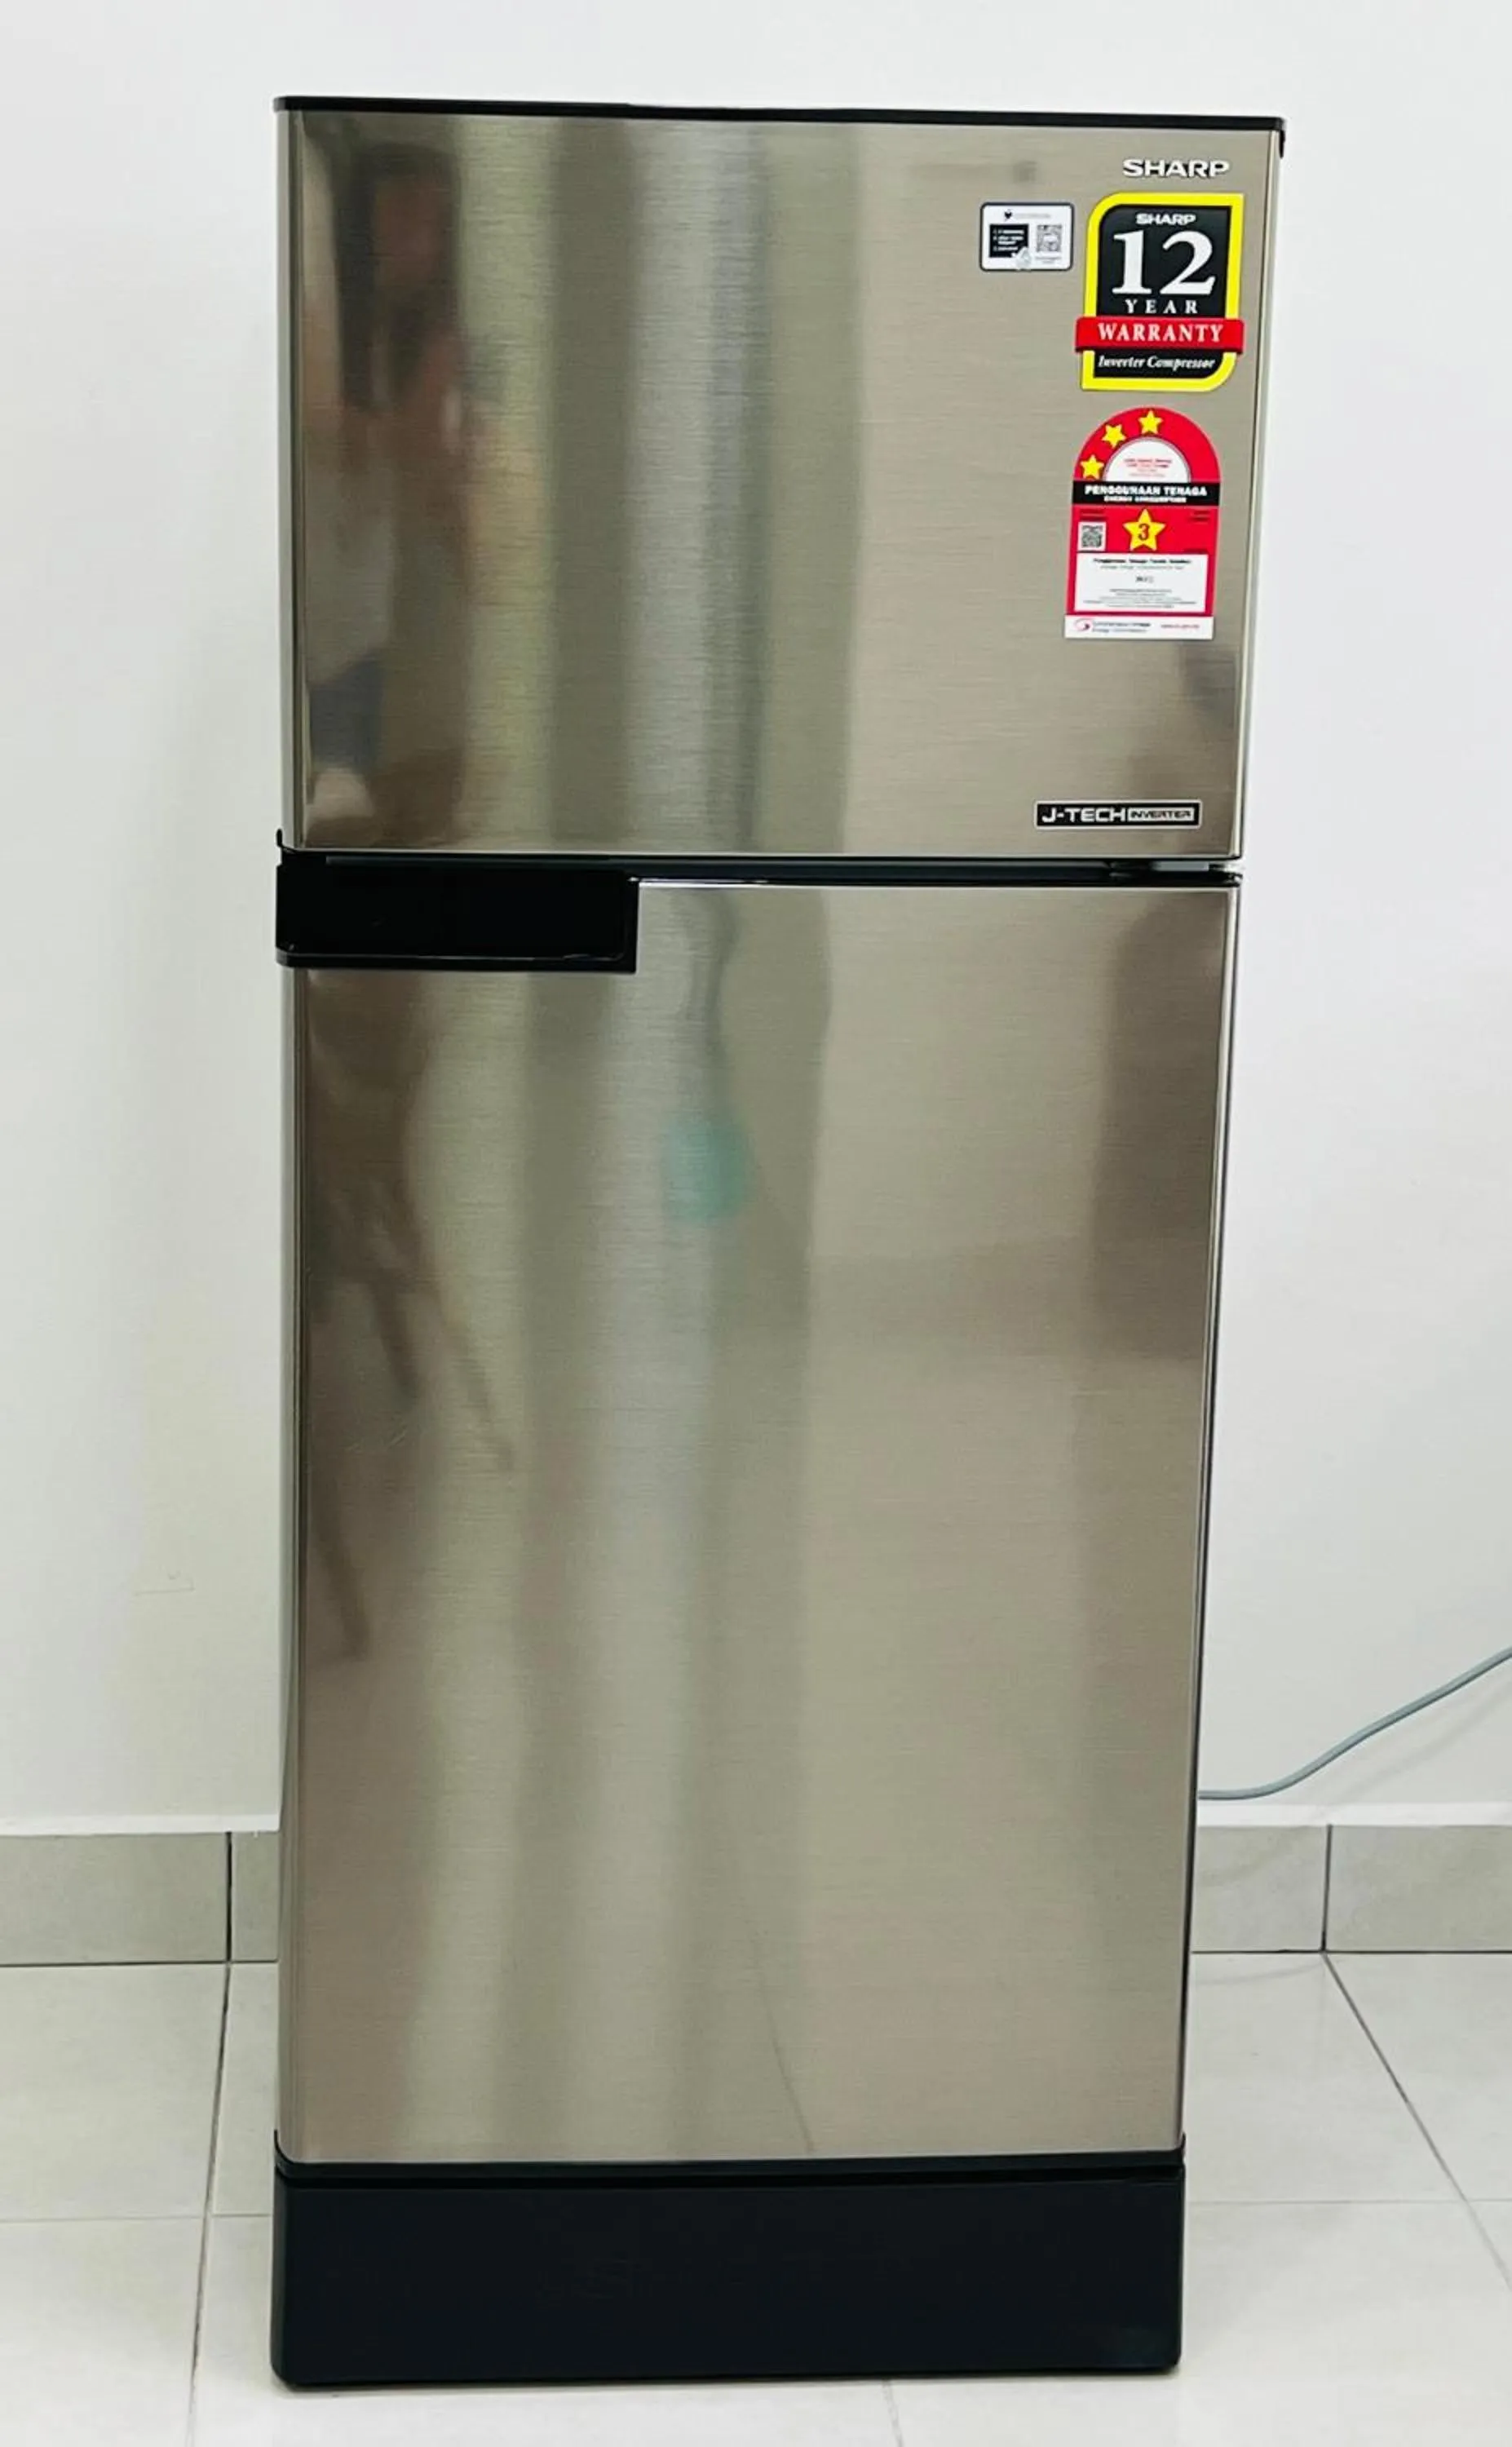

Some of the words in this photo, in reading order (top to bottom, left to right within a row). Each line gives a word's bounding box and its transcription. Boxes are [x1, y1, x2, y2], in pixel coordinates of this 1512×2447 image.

[1123, 159, 1230, 179] SHARP
[1136, 213, 1196, 226] SHARP
[1112, 230, 1216, 294] 12
[1125, 299, 1198, 314] YEAR
[1098, 323, 1224, 343] WARRANTY
[1099, 355, 1145, 368] Inverter
[1147, 355, 1216, 372] Compressor
[1085, 485, 1161, 496] PENGGUNAAN
[1163, 486, 1208, 497] TENAGA
[1138, 523, 1150, 542] 3
[1041, 808, 1126, 823] J-TECH
[1130, 809, 1191, 820] INVERTER
